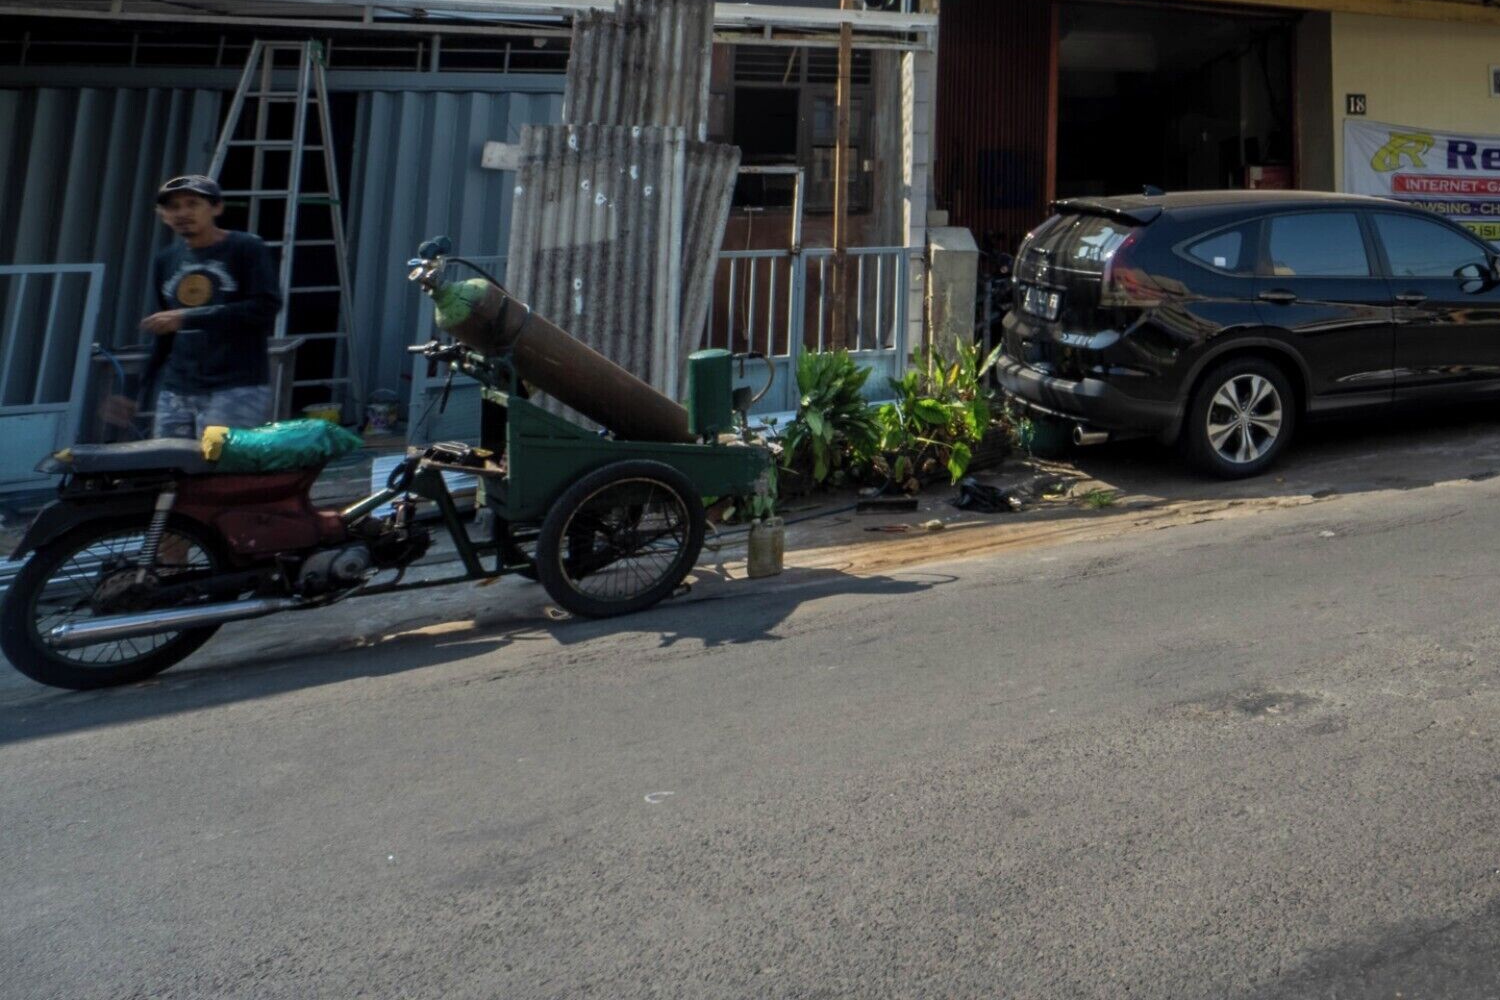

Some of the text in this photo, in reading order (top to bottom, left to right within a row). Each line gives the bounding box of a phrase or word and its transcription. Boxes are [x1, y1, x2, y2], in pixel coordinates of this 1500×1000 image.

[1350, 97, 1366, 112] 18
[1405, 178, 1479, 192] INTERNET
[1480, 225, 1496, 237] ISI
